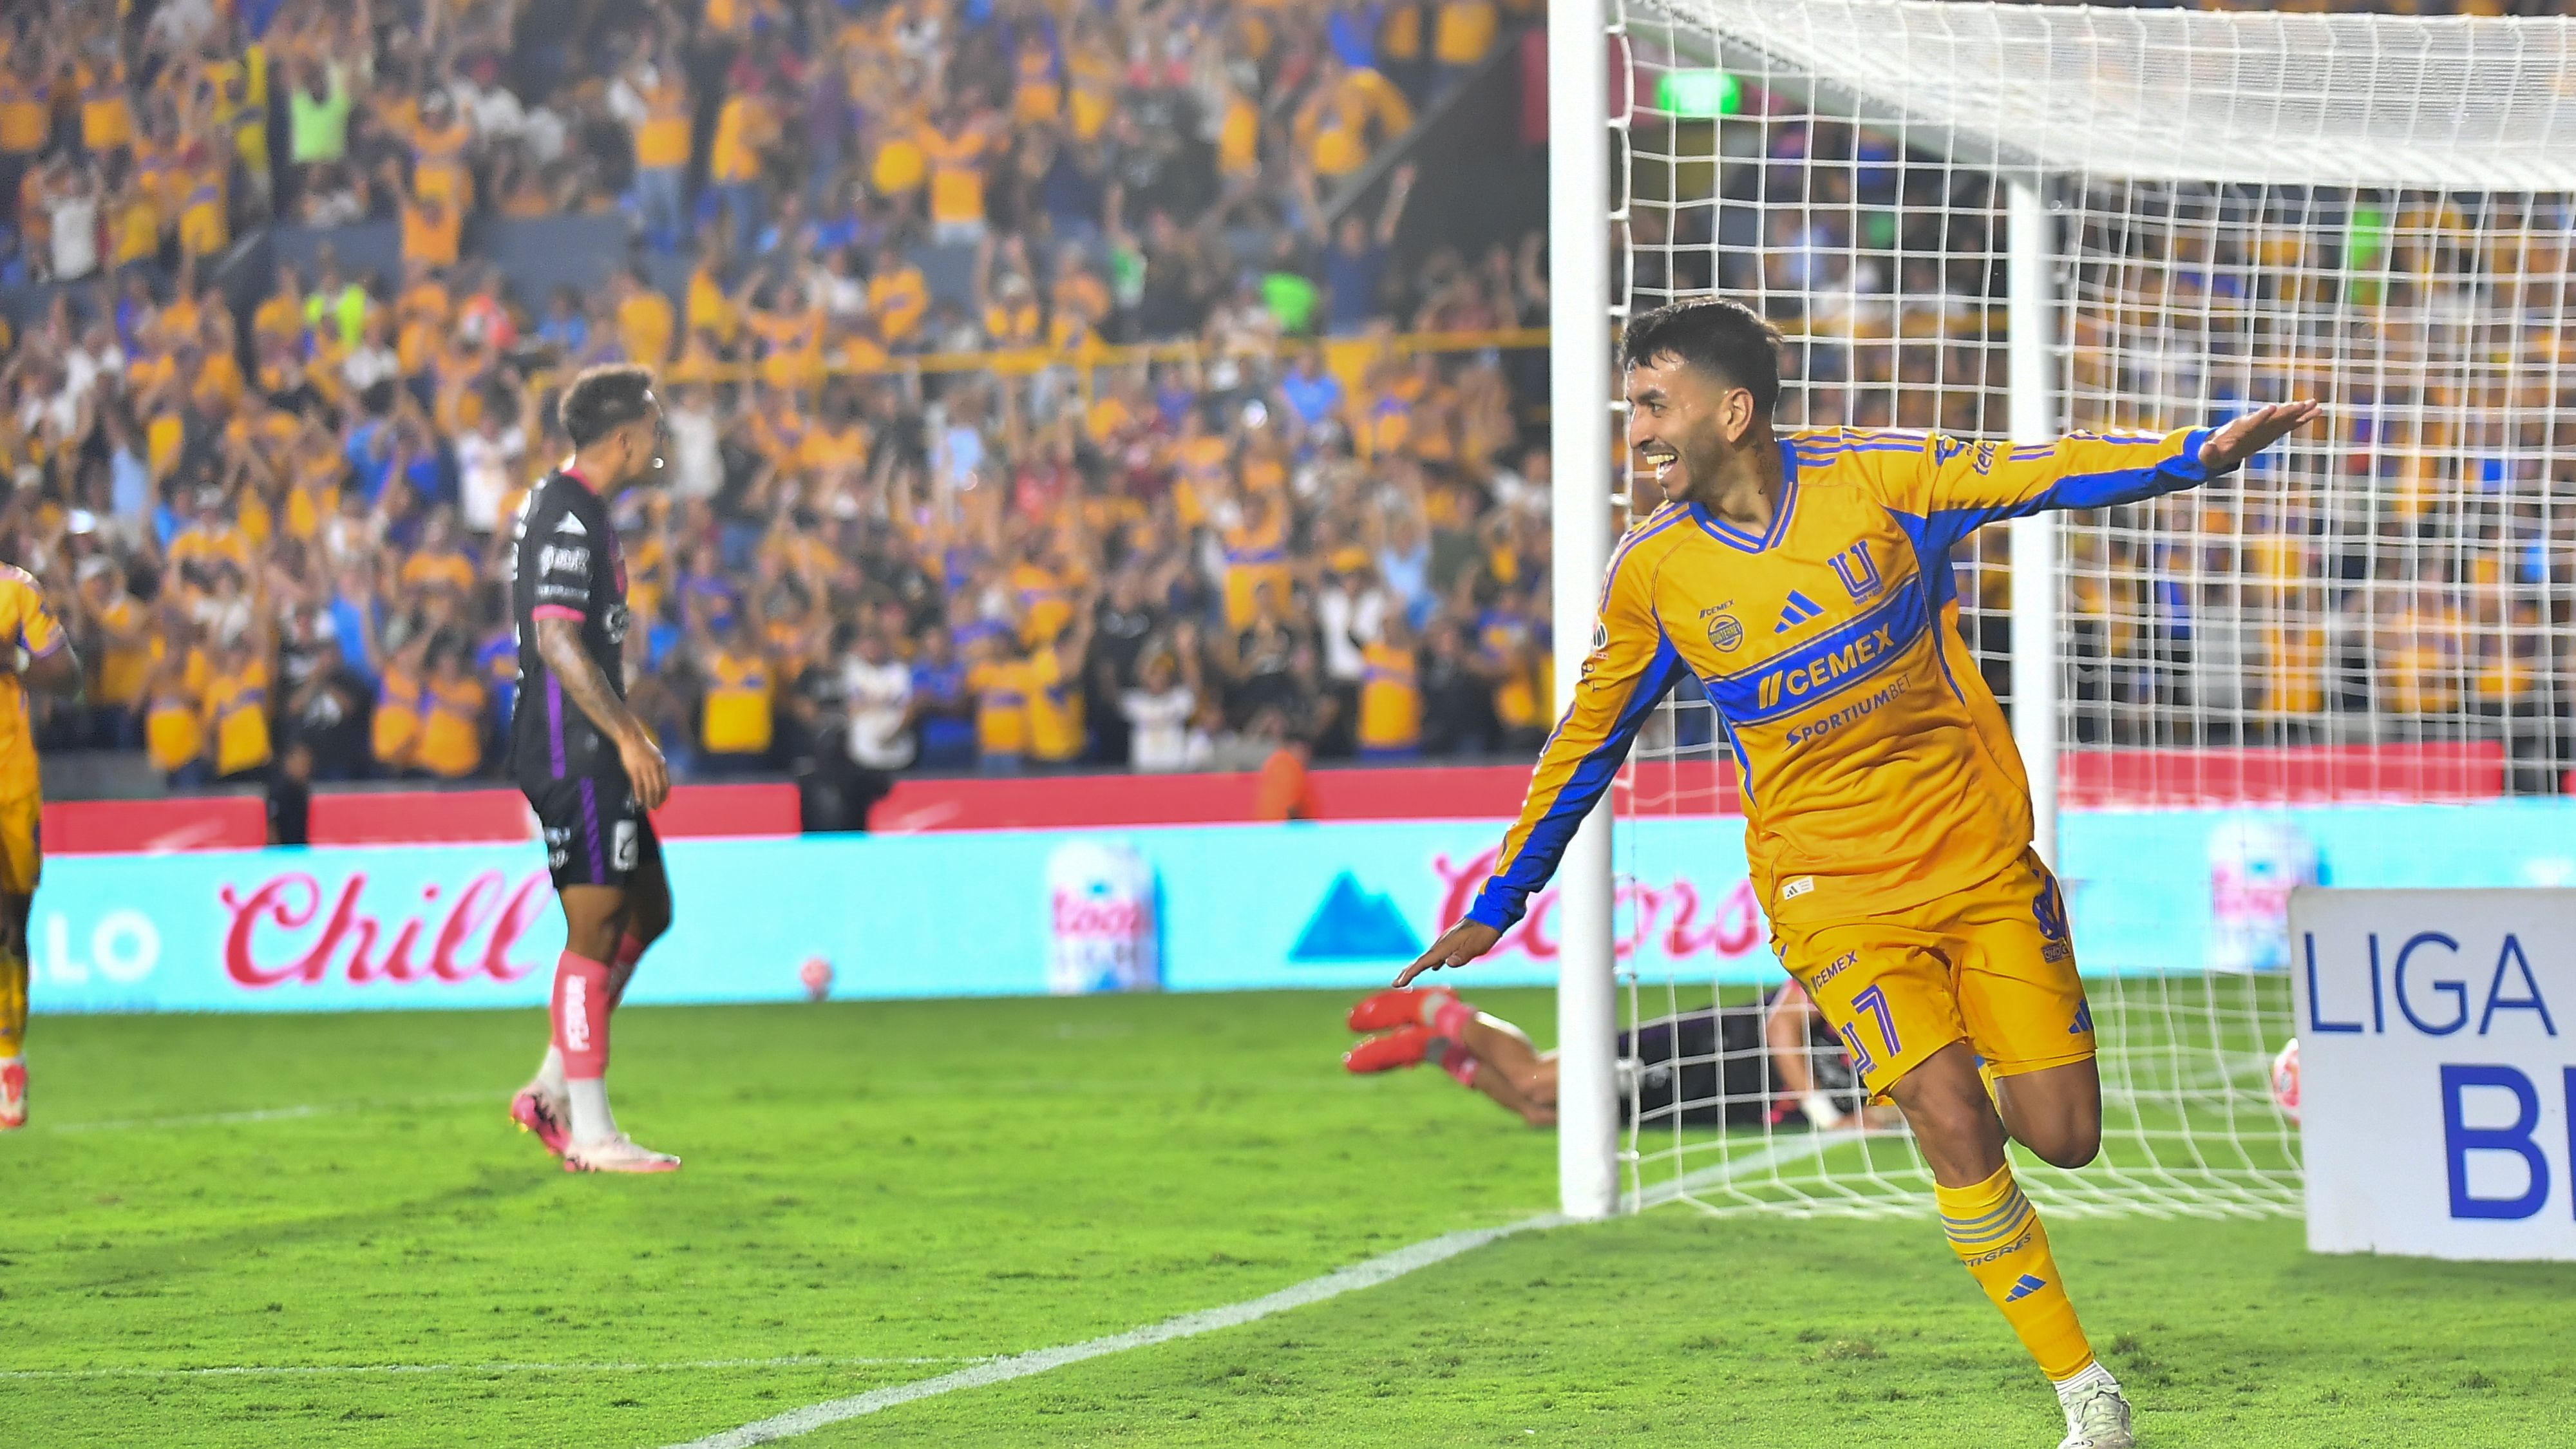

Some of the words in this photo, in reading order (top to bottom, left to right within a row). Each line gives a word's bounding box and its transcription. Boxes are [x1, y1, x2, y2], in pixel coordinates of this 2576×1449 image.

[1786, 623, 1895, 696] CEMEX
[1783, 672, 1913, 753] SPORTIUMBET
[30, 909, 161, 984] LO
[220, 870, 554, 989] Chill
[1816, 950, 1859, 987] CEMEX
[2304, 931, 2558, 1037] LIGA
